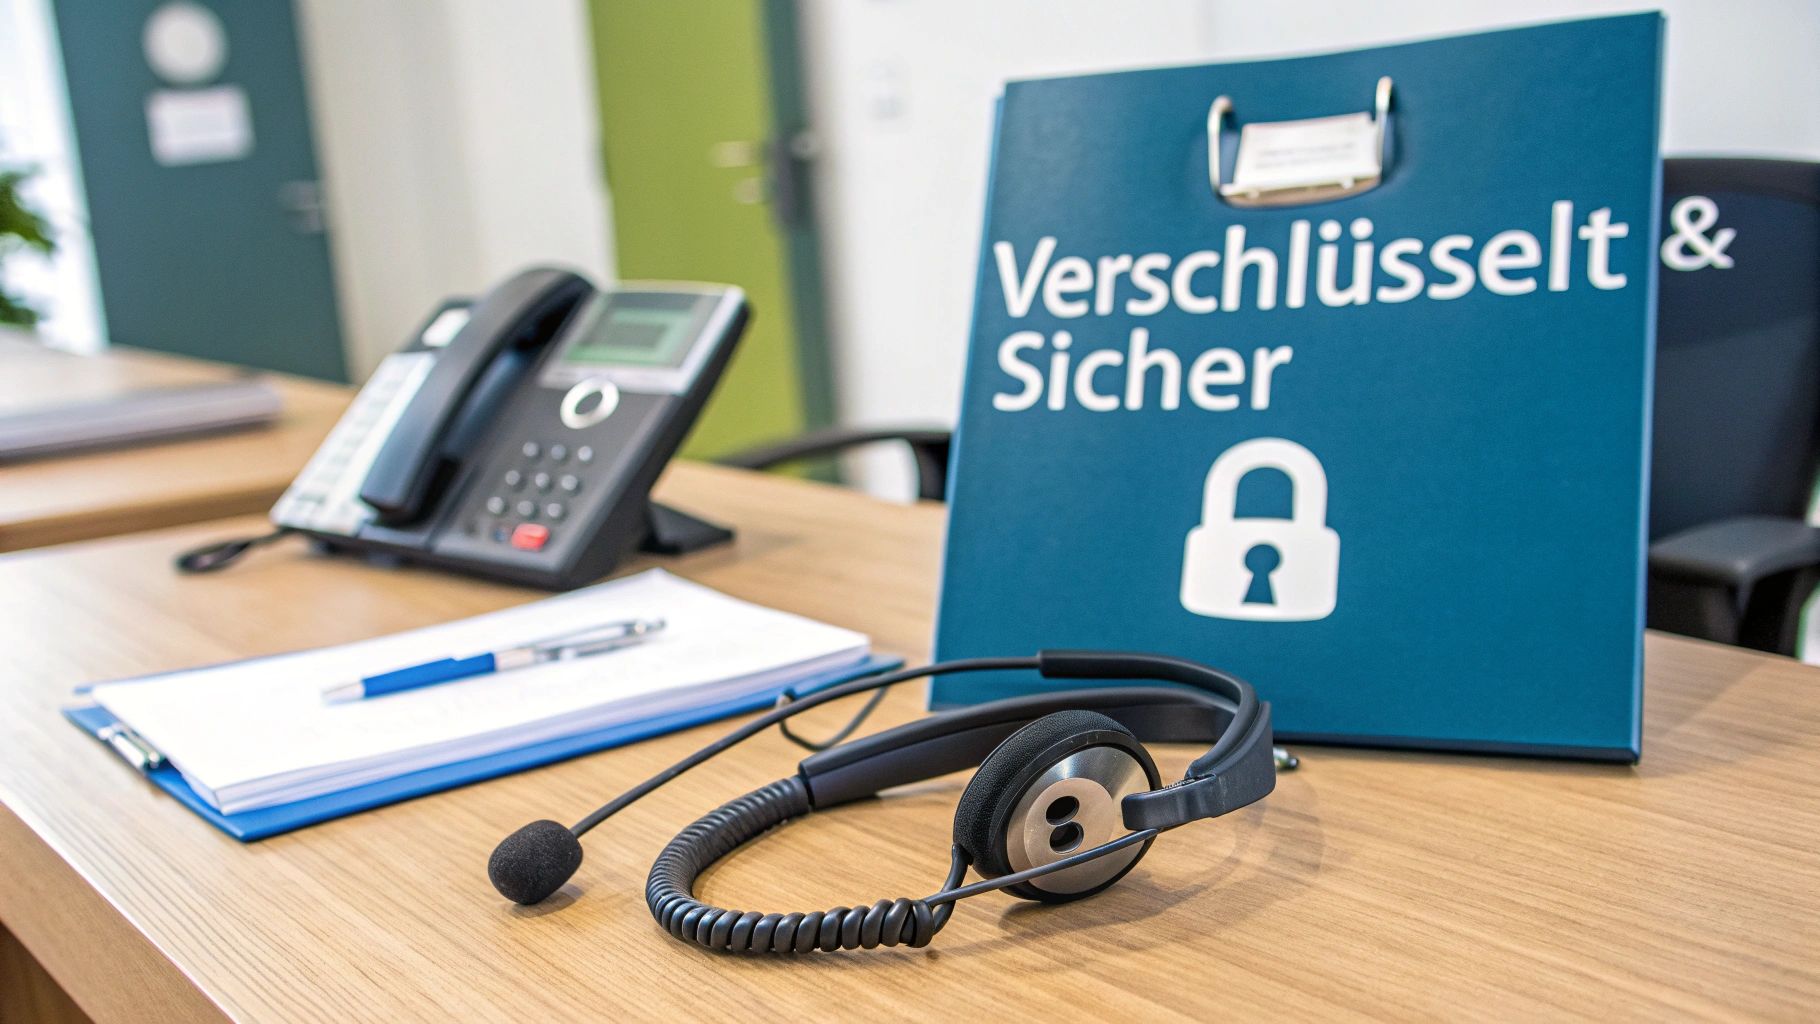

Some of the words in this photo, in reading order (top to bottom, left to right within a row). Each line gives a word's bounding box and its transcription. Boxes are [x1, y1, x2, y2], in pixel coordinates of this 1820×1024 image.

[993, 200, 1629, 319] Verschlüsselt
[1661, 196, 1736, 271] &
[992, 326, 1293, 412] Sicher
